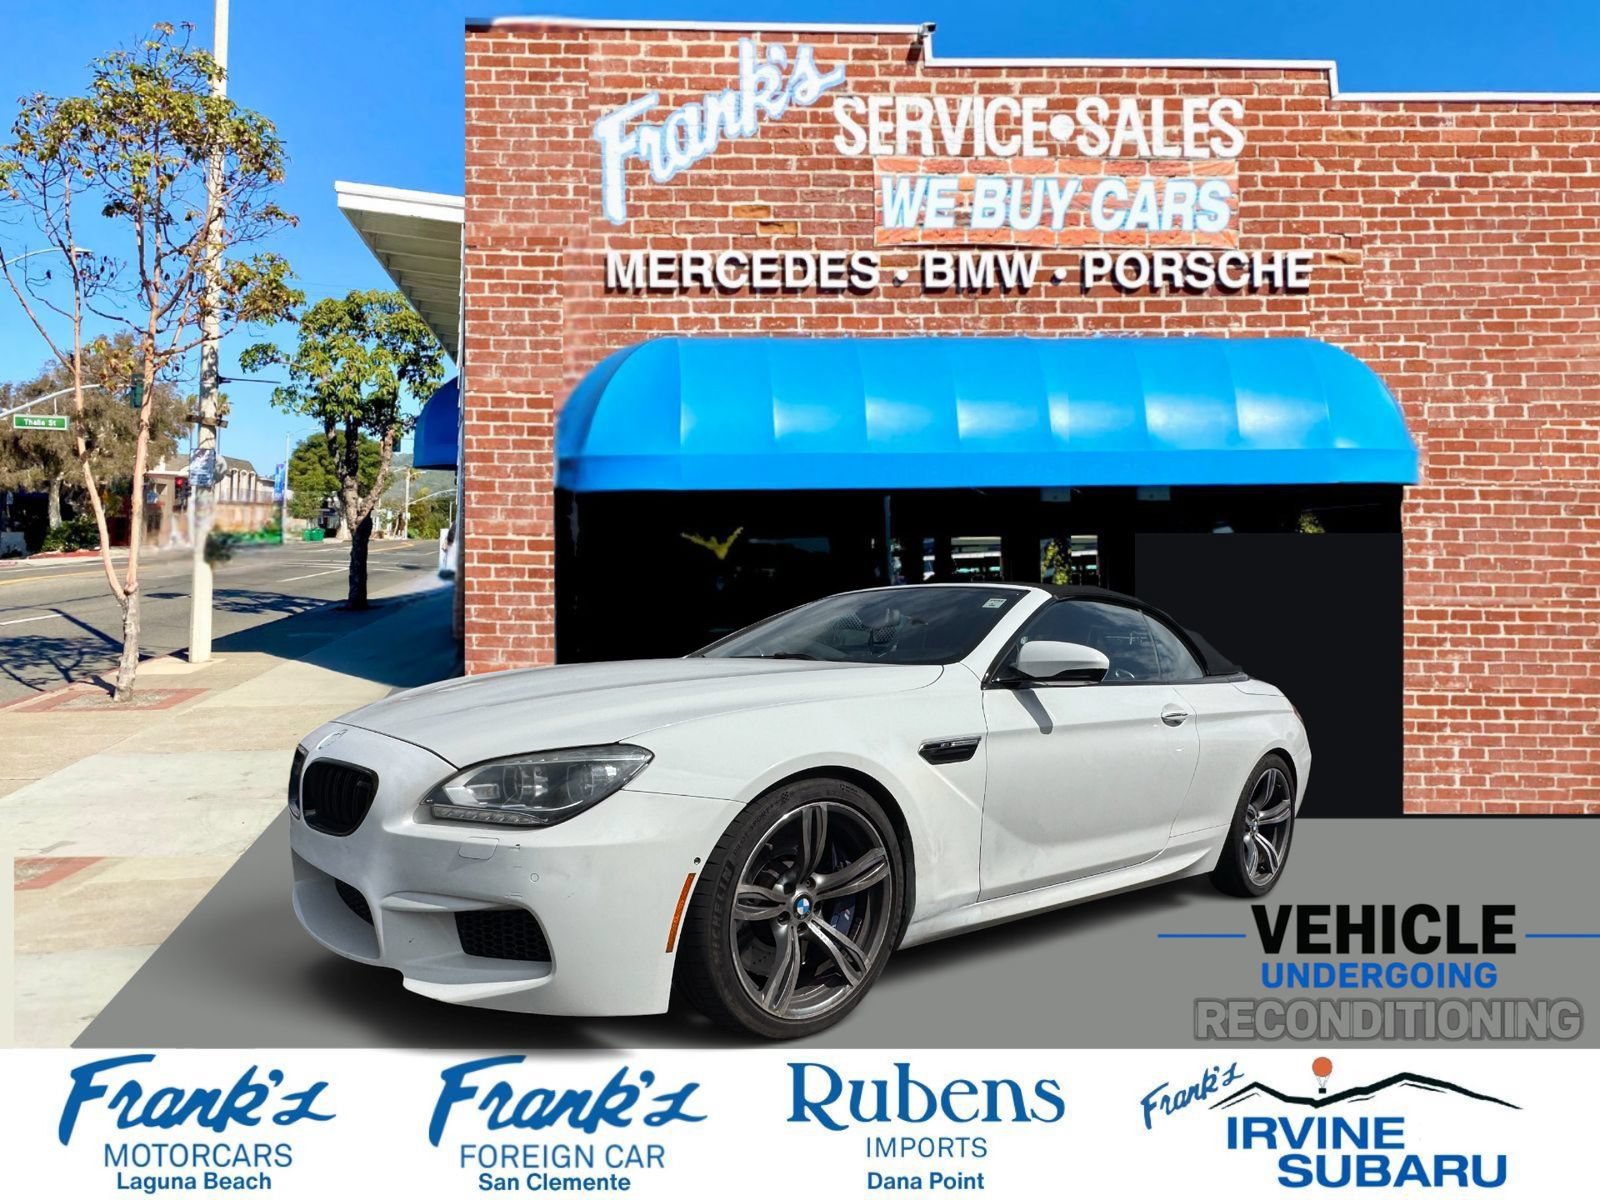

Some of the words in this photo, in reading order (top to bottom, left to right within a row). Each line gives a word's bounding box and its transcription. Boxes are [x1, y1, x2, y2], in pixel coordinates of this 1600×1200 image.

[593, 37, 846, 225] Frank's
[881, 175, 959, 230] WE
[970, 176, 1082, 232] BUY
[1090, 177, 1233, 233] CARS
[605, 250, 881, 291] MERCEDES
[922, 250, 1042, 291] BMW
[1082, 250, 1314, 291] PORSCHE
